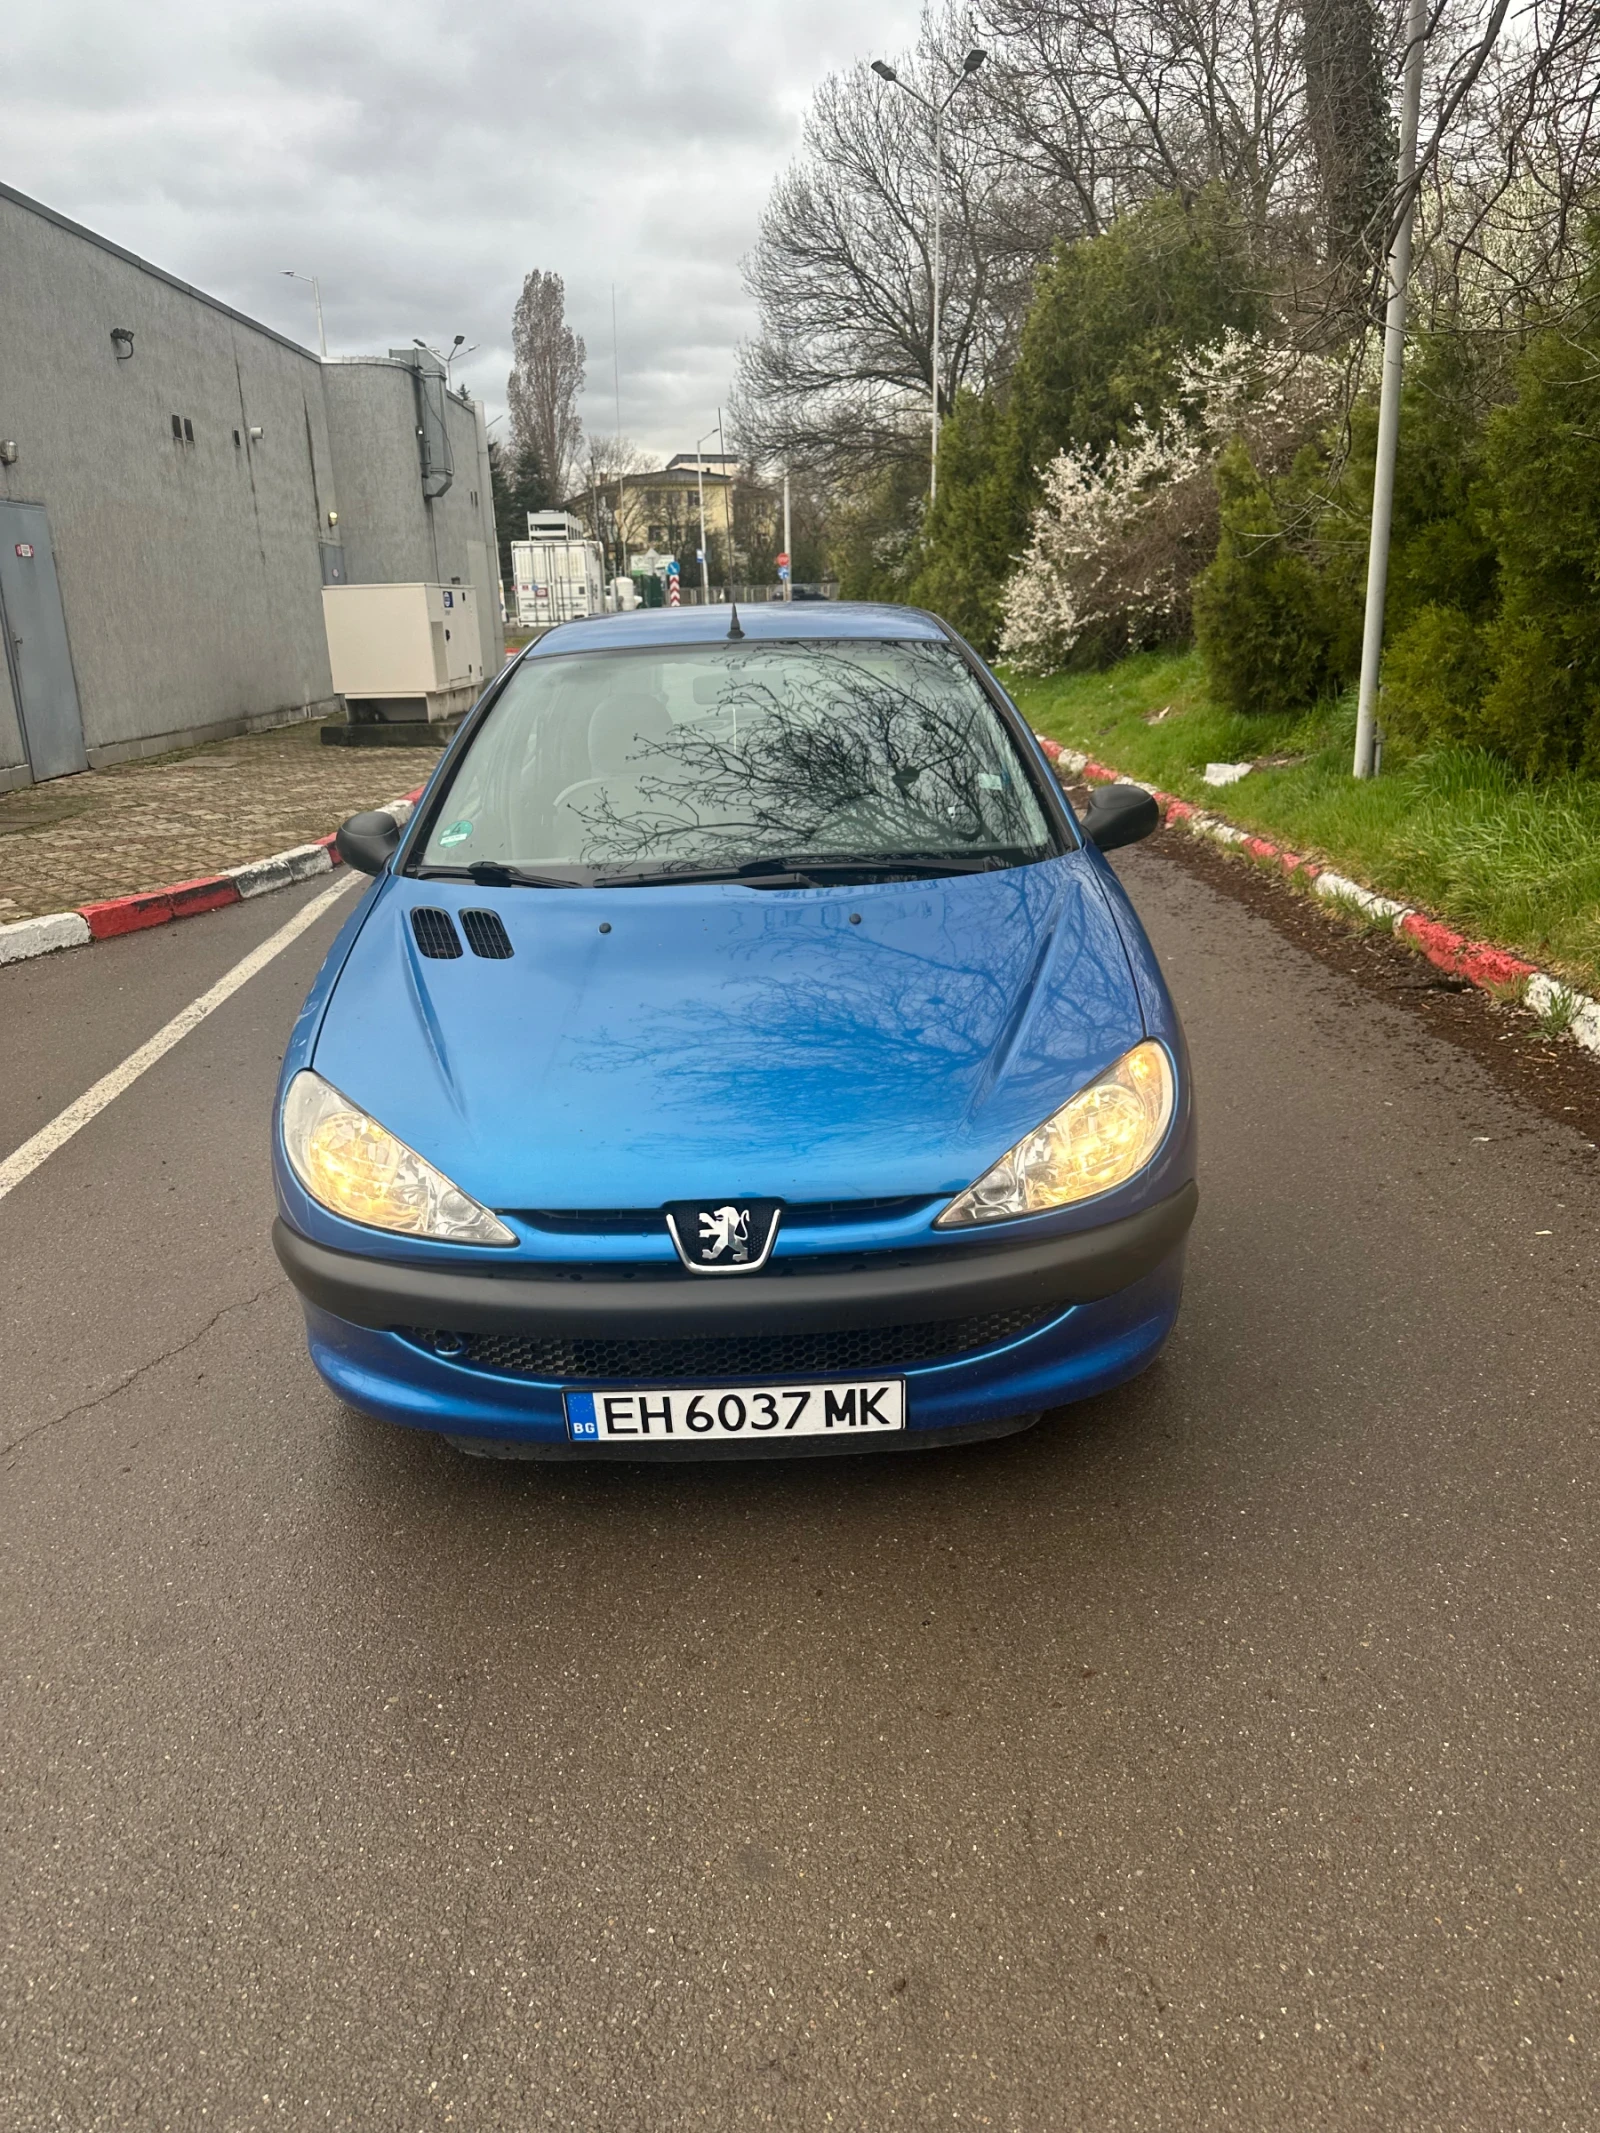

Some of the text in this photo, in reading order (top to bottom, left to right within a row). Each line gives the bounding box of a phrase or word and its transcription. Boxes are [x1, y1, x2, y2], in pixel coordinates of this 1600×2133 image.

[603, 1387, 890, 1434] EH 6037 MK
[573, 1422, 595, 1434] BG
